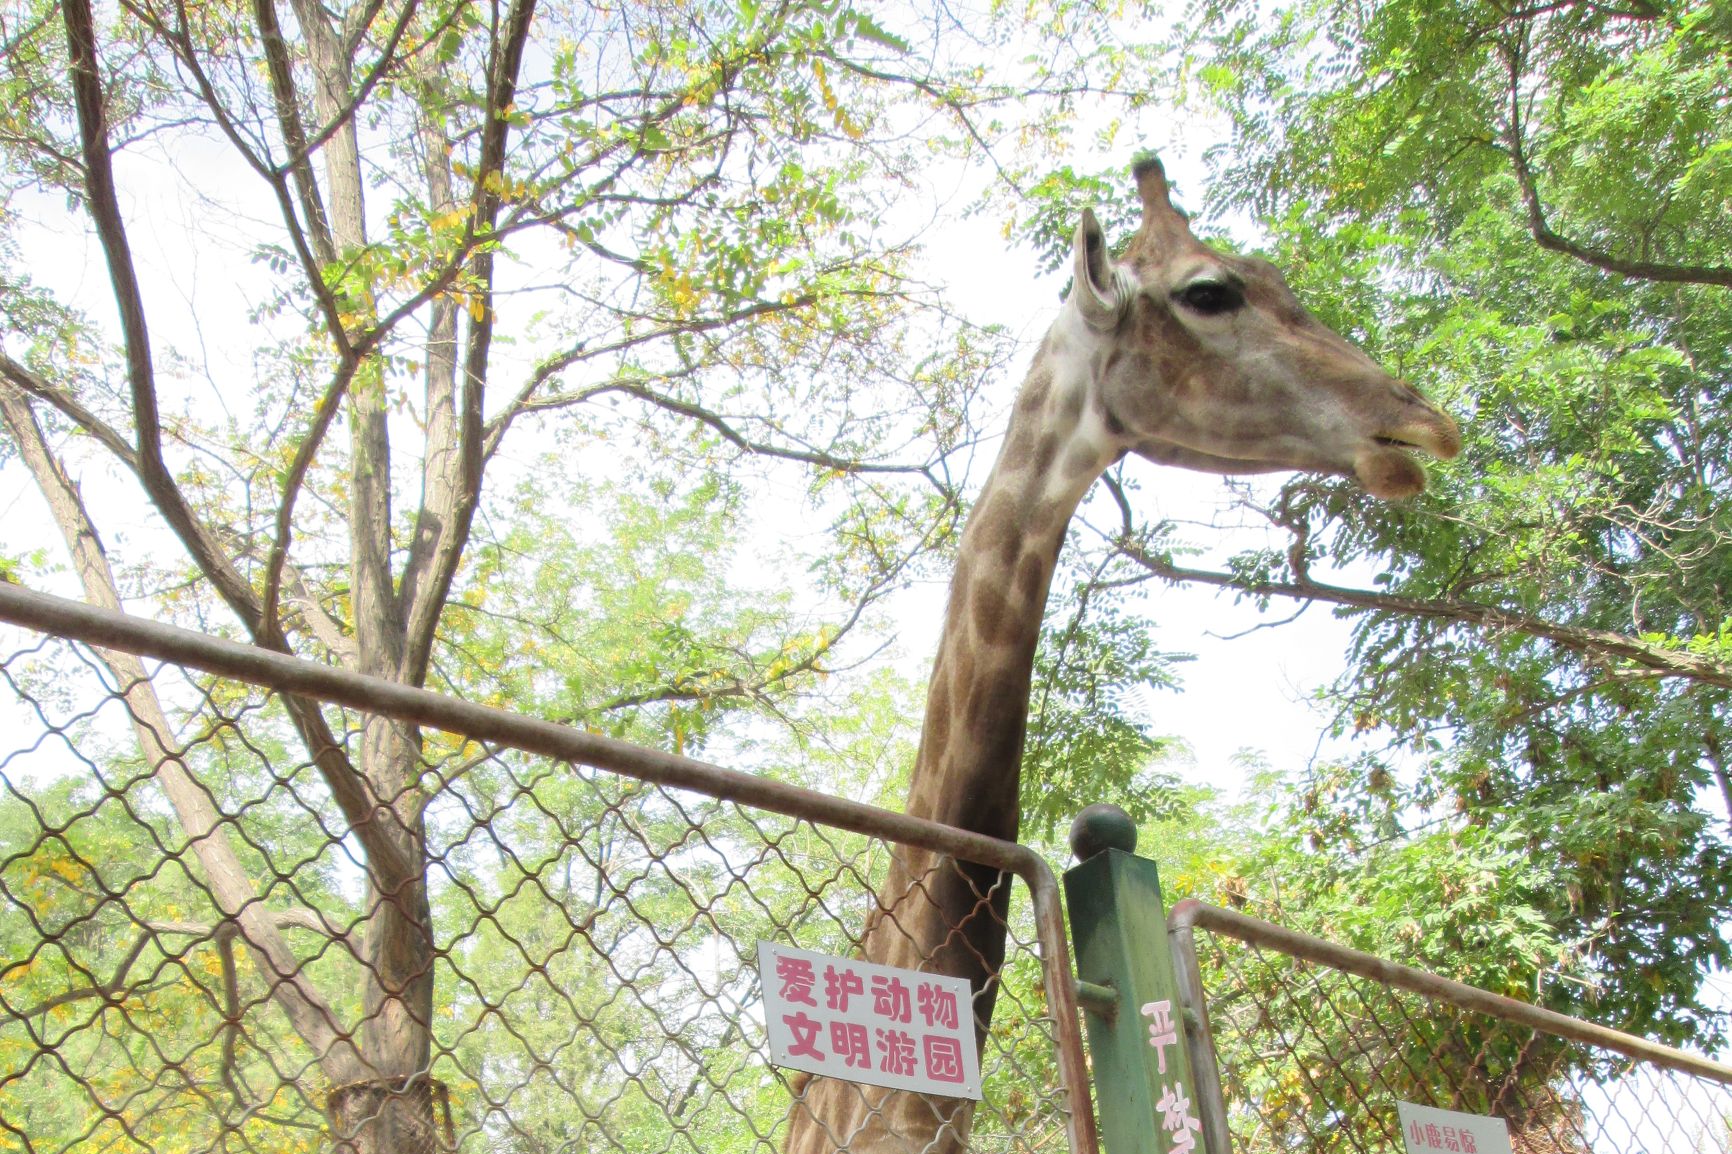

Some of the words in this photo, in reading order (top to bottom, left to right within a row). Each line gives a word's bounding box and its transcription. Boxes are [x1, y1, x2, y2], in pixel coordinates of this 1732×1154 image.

[776, 956, 959, 1030] 爱护动物
[782, 1012, 965, 1083] 文明游园
[1410, 1120, 1477, 1154] 小鹿易惊
